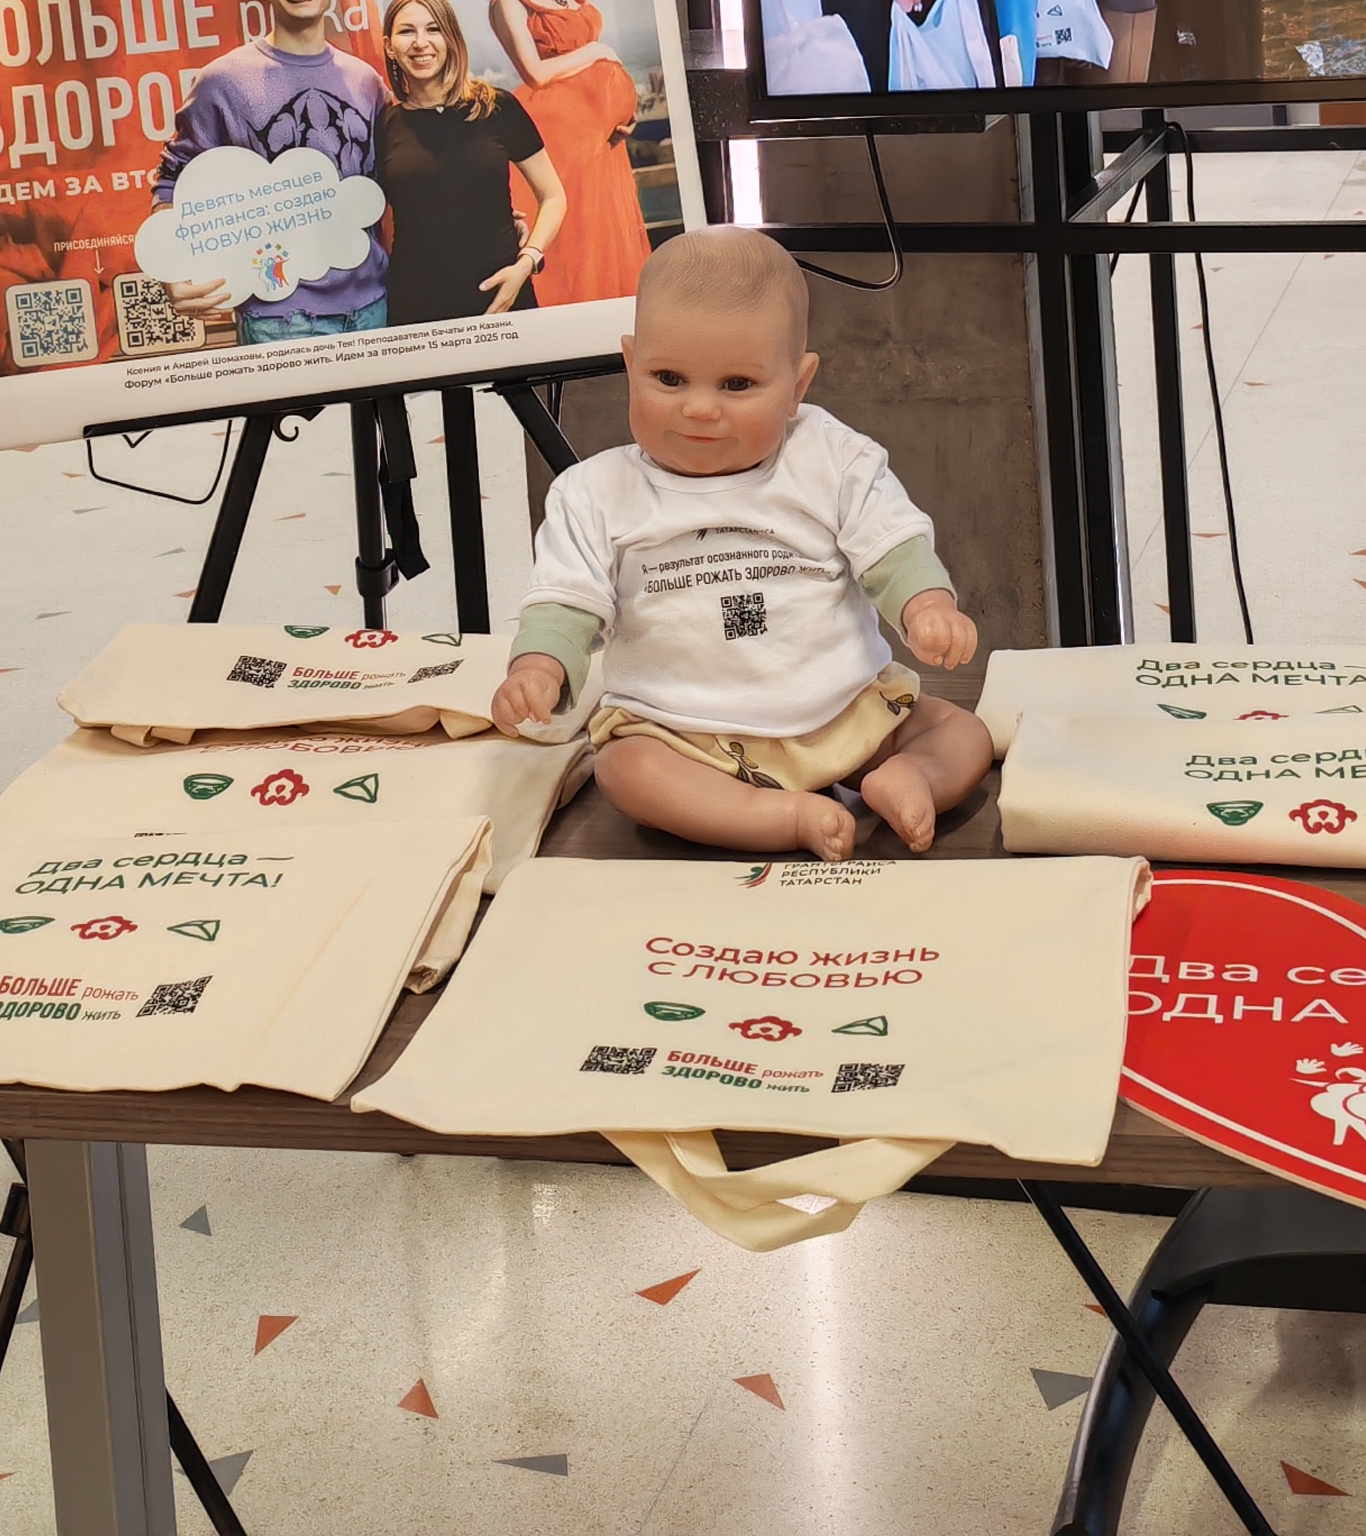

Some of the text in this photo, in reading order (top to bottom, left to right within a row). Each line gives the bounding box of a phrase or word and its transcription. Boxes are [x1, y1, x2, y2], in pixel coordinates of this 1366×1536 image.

[64, 174, 103, 197] ЗА
[174, 186, 337, 242] фриланса: создаю
[190, 208, 334, 257] НОВУЮ ЖИЗНЬ
[124, 332, 498, 391] Форум «Больше рожать здорово жить. Идем вторым» марта 2025
[659, 547, 770, 573] результат осознанного
[696, 564, 796, 585] РОЖАТЬ ЗДОРОВО
[292, 666, 361, 680] БОЛЬШЕ
[1137, 658, 1336, 673] Два сердца
[1135, 672, 1241, 688] ОДНА
[26, 851, 249, 878] Два сердца
[781, 866, 882, 878] РЕСПУБЛИКИ
[14, 871, 284, 895] ОДНА МЕЧТА!
[779, 877, 863, 887] ТАТАРСТАН
[645, 936, 941, 967] Создаю жизнь
[647, 961, 923, 989] С ЛЮБОВЬЮ
[1128, 954, 1260, 984] Два
[81, 986, 140, 1002] рожать
[81, 1008, 122, 1021] жить
[666, 1049, 825, 1081] БОЛЬШЕ рожать
[661, 1065, 811, 1094] ЗДОРОВО жить
